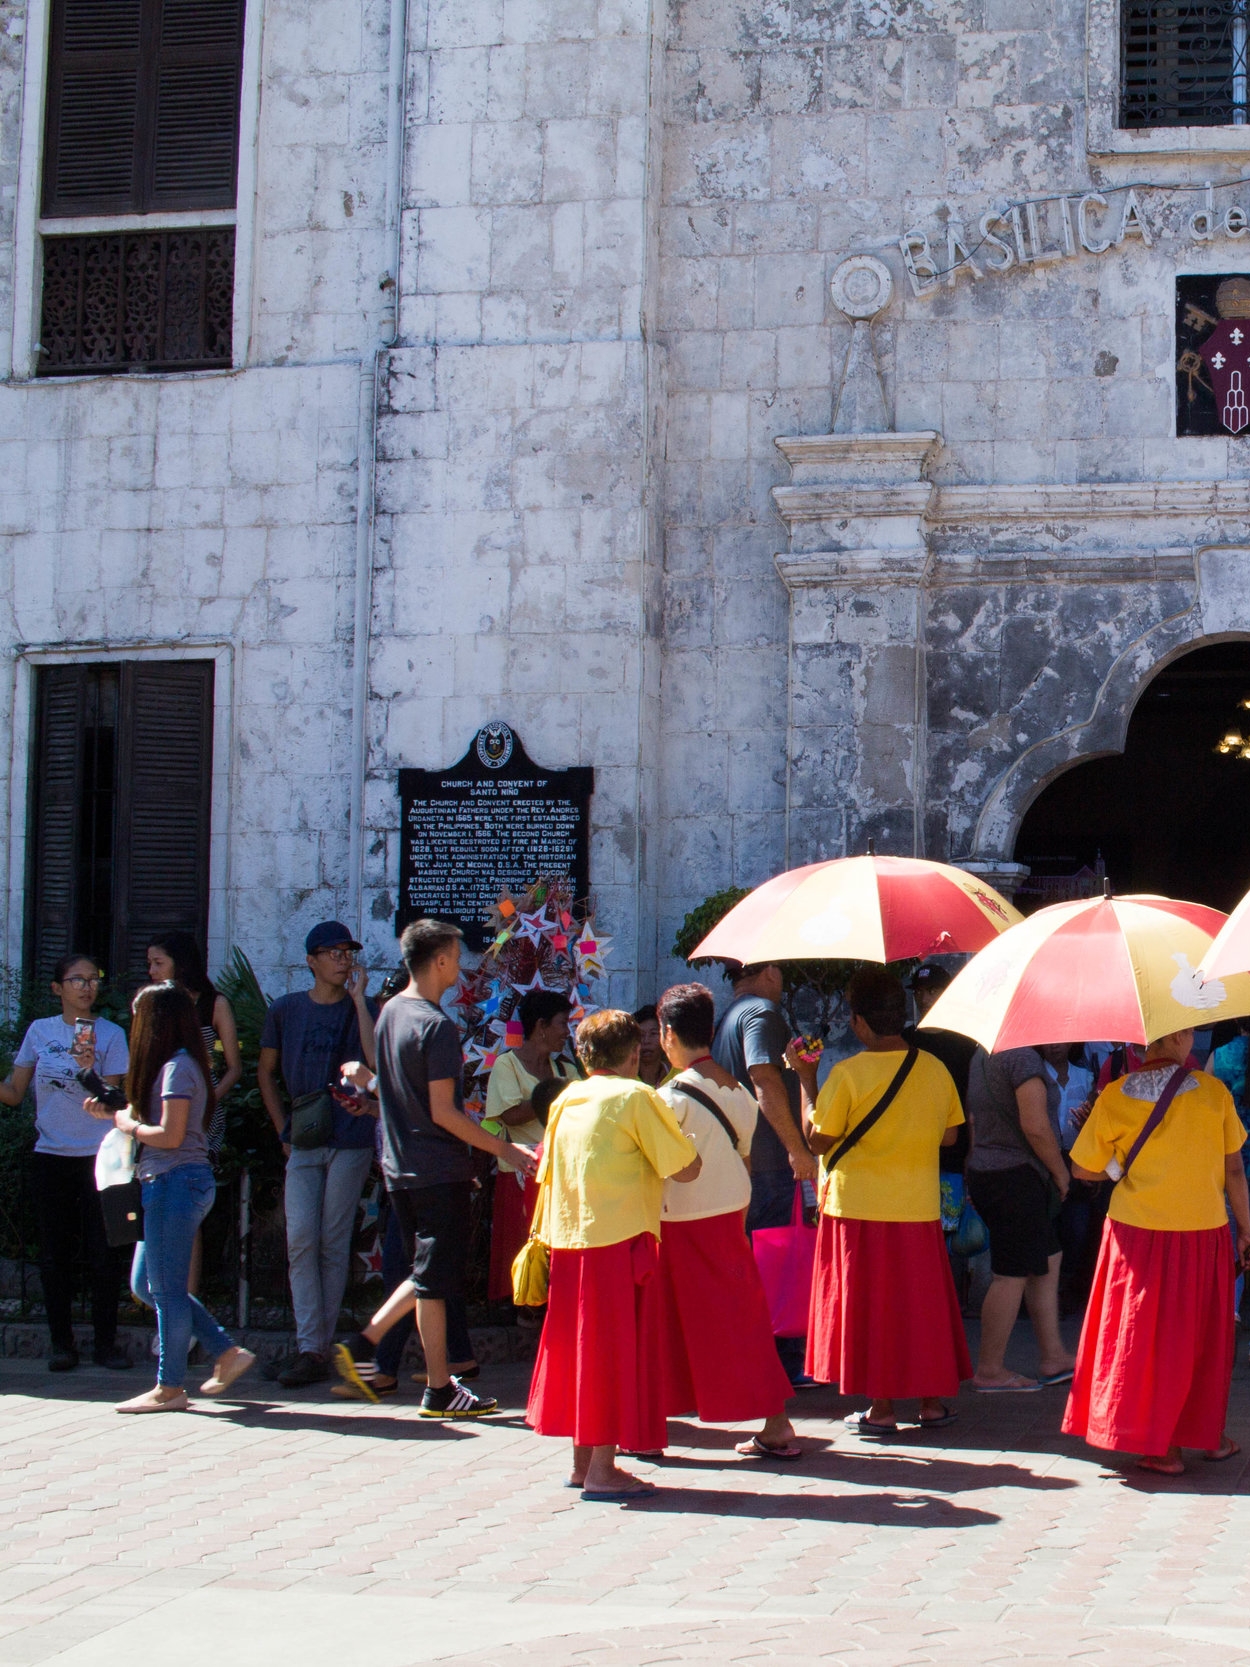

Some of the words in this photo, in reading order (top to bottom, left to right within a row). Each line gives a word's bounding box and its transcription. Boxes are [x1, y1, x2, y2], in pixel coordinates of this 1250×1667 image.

[900, 188, 1152, 297] BASILICA
[441, 780, 473, 788] CHURCH
[476, 780, 494, 788] AND
[497, 780, 535, 788] CONVENT
[537, 780, 548, 788] OF
[470, 788, 498, 796] SANTO
[501, 786, 519, 796] NIÑO
[418, 830, 427, 838] ON
[429, 830, 467, 838] NOVEMBER
[496, 830, 510, 838] THE
[512, 830, 539, 838] SECOND
[541, 830, 570, 838] CHURCH
[414, 861, 431, 869] REV.
[433, 861, 453, 869] JUAN
[456, 861, 465, 869] DE
[524, 861, 537, 869] THE
[539, 861, 571, 869] PRESENT
[407, 884, 446, 892] ALBARRAN
